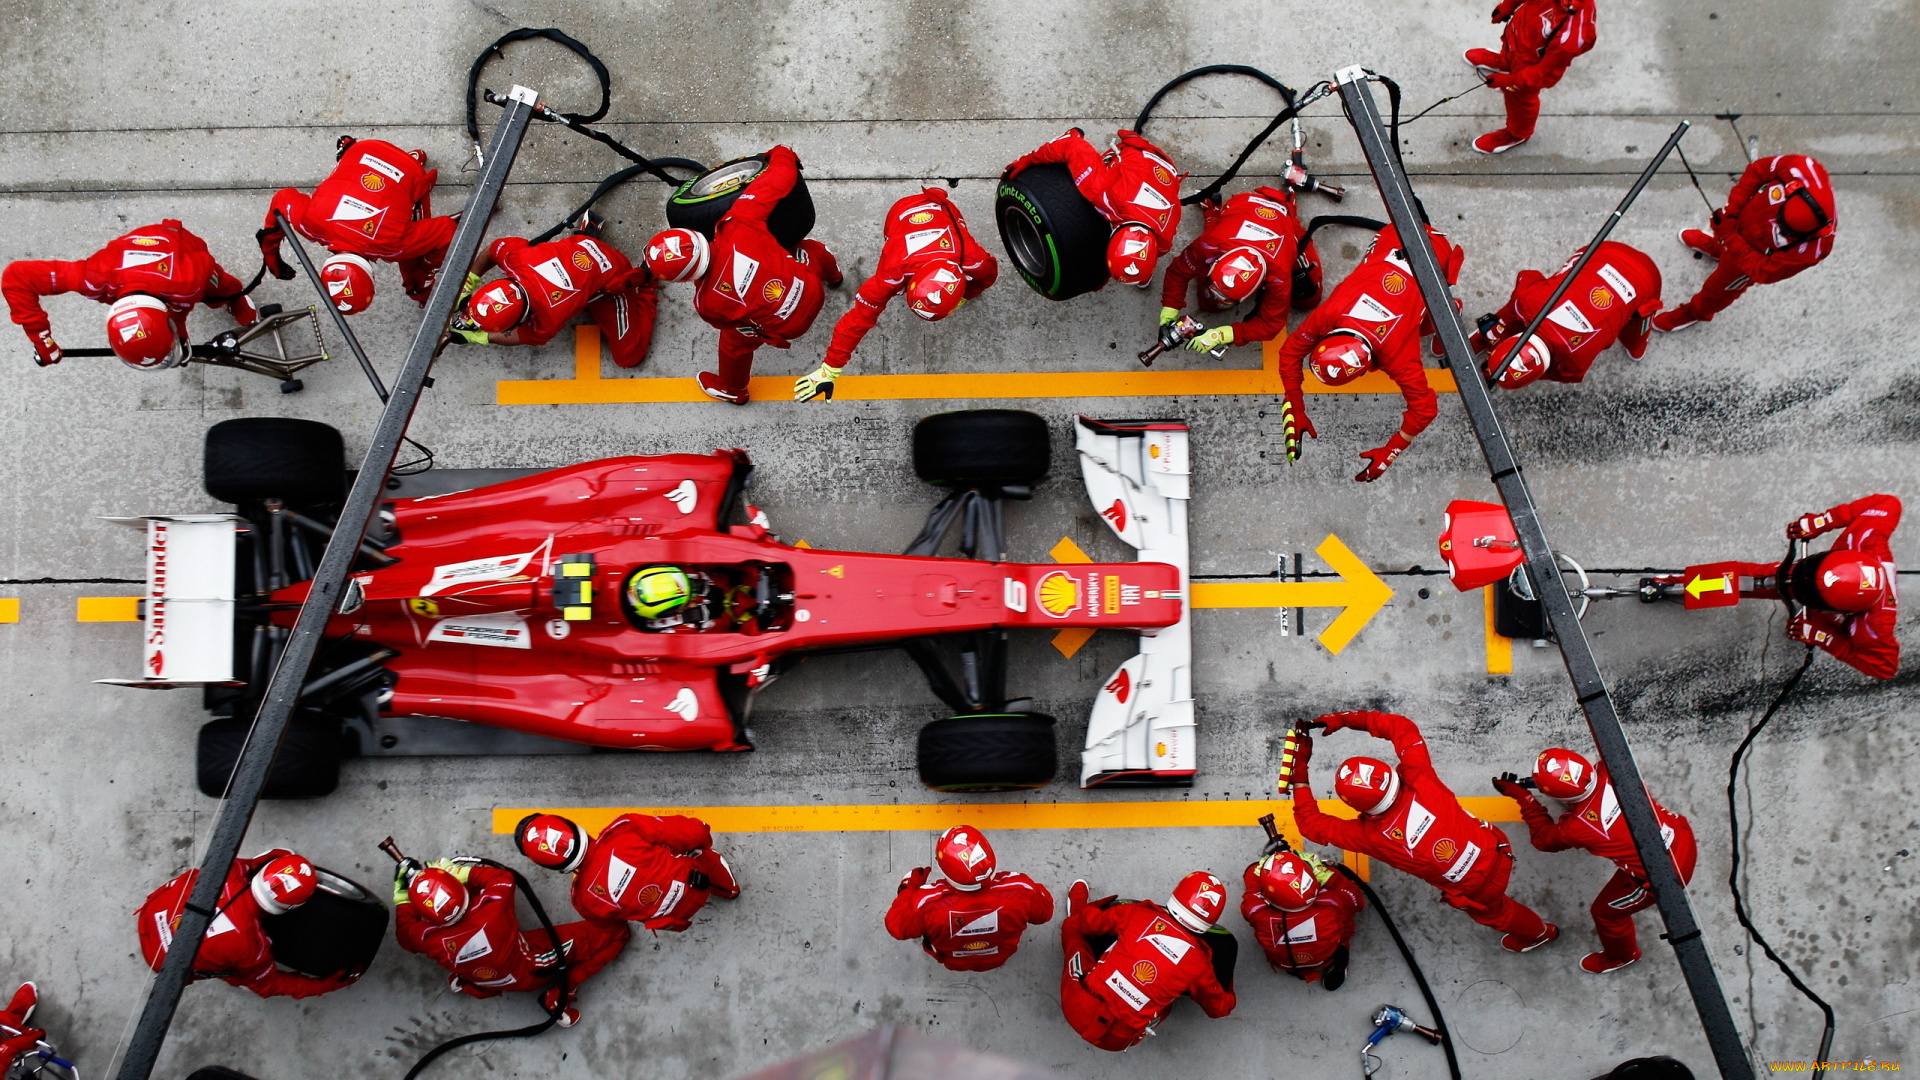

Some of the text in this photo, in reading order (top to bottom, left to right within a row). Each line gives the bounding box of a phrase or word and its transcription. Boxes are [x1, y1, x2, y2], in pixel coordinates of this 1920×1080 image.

[1000, 184, 1042, 225] Cinturato
[148, 521, 168, 646] Santander
[1004, 577, 1027, 613] 6
[1086, 577, 1100, 618] KASPERSKY
[1120, 584, 1141, 606] FIAT
[1454, 847, 1476, 876] Santander
[1116, 981, 1144, 1006] Santander
